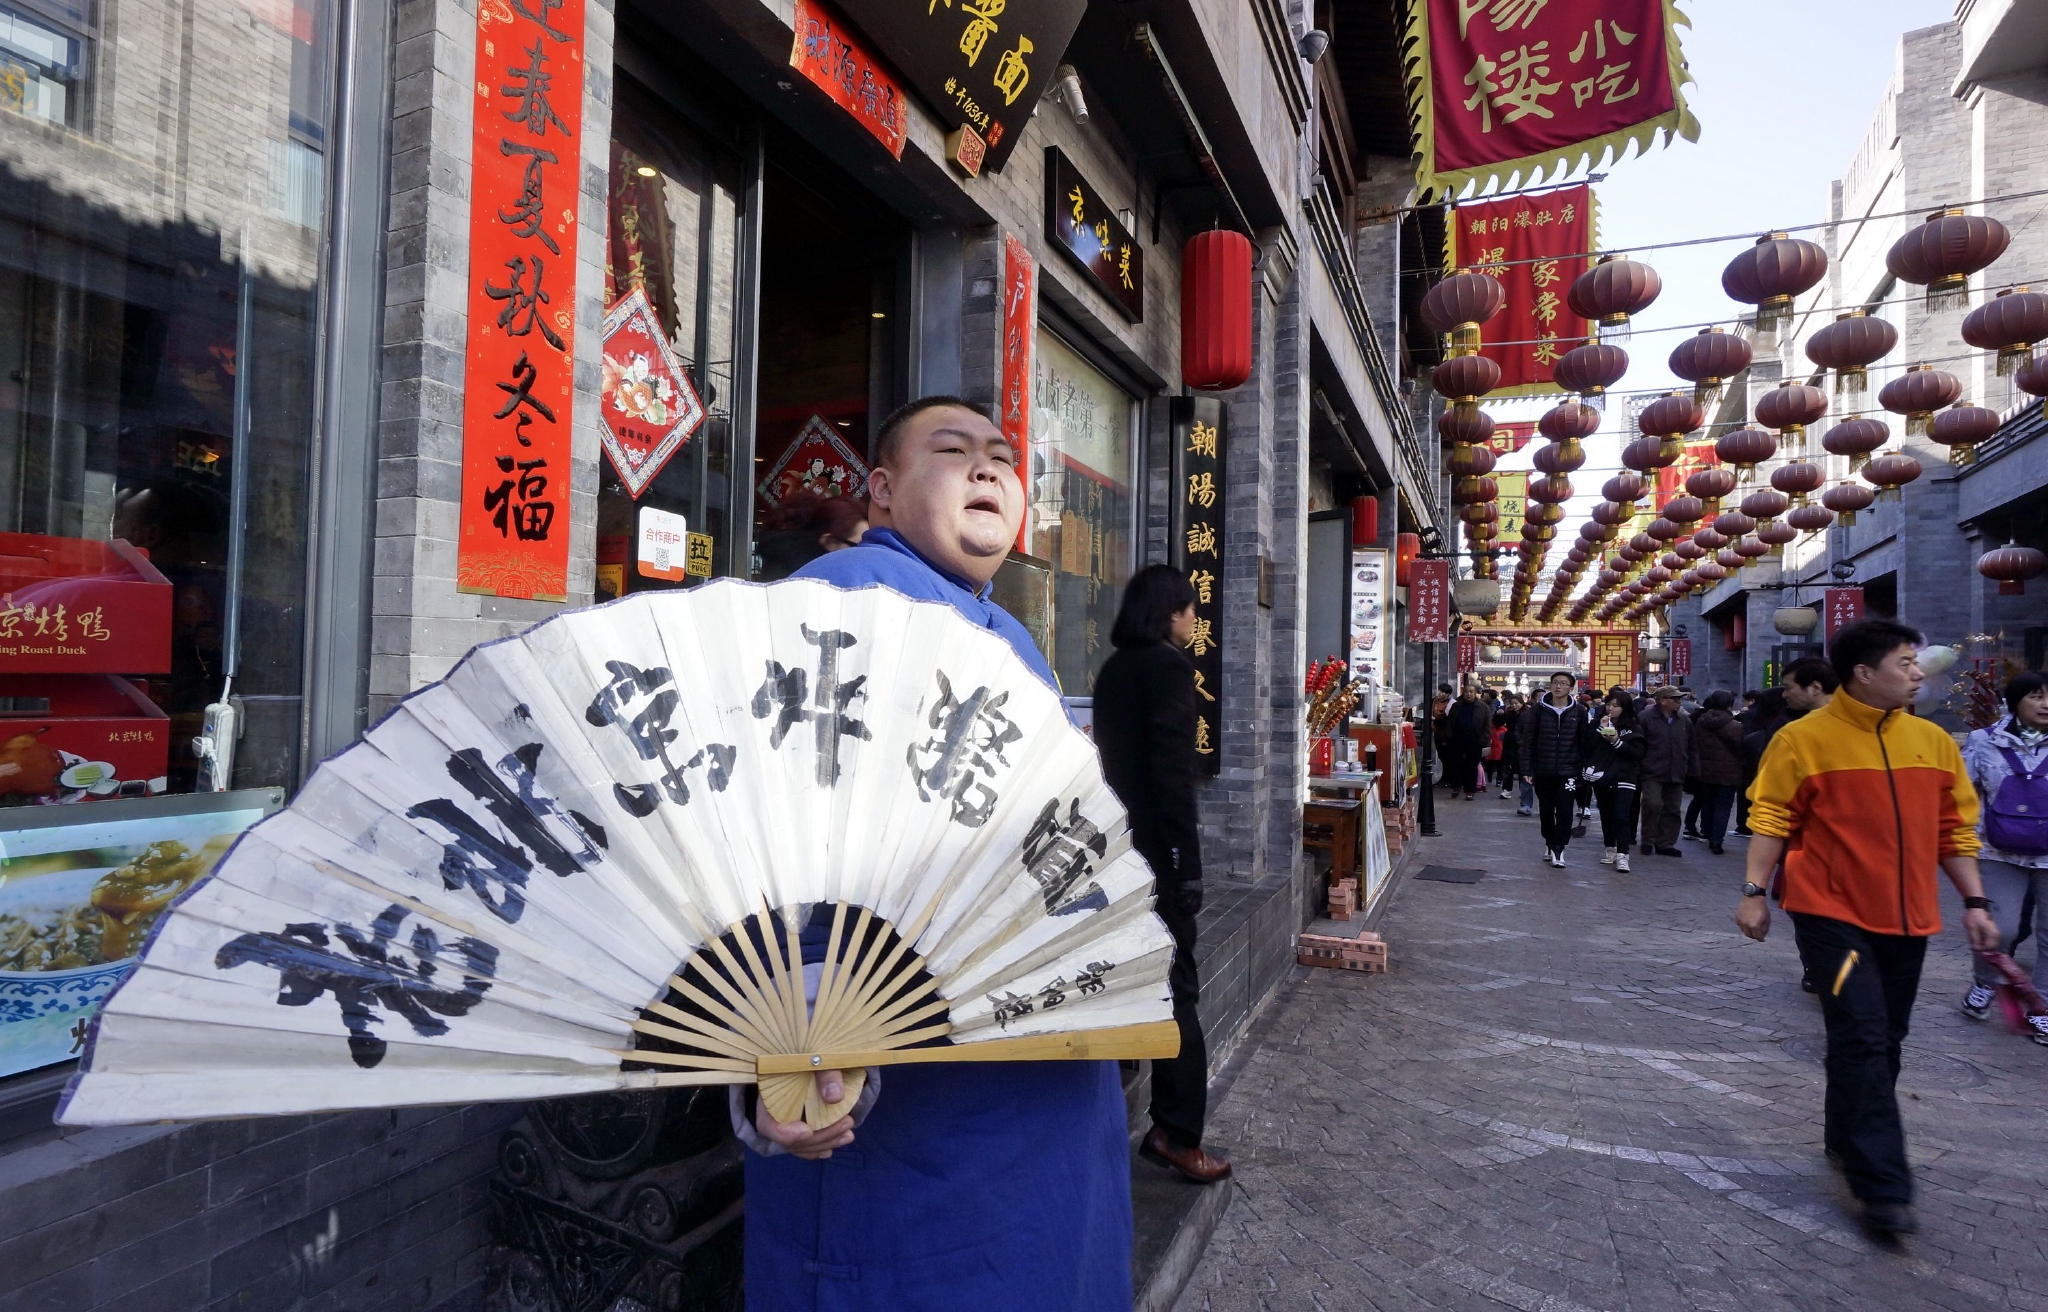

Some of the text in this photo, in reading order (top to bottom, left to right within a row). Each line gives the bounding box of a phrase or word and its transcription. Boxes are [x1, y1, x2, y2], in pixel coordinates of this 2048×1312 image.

[1569, 19, 1639, 109] 小吃
[1469, 203, 1576, 236] 朝阳爆肚店
[1068, 183, 1134, 290] 京味菜
[1531, 255, 1563, 366] 家常菜
[1503, 500, 1521, 534] 烧麦
[646, 527, 681, 545] 合作商户
[690, 537, 710, 561] 拉
[691, 564, 708, 574] PULL
[21, 645, 53, 655] Roast
[57, 645, 87, 655] Duck
